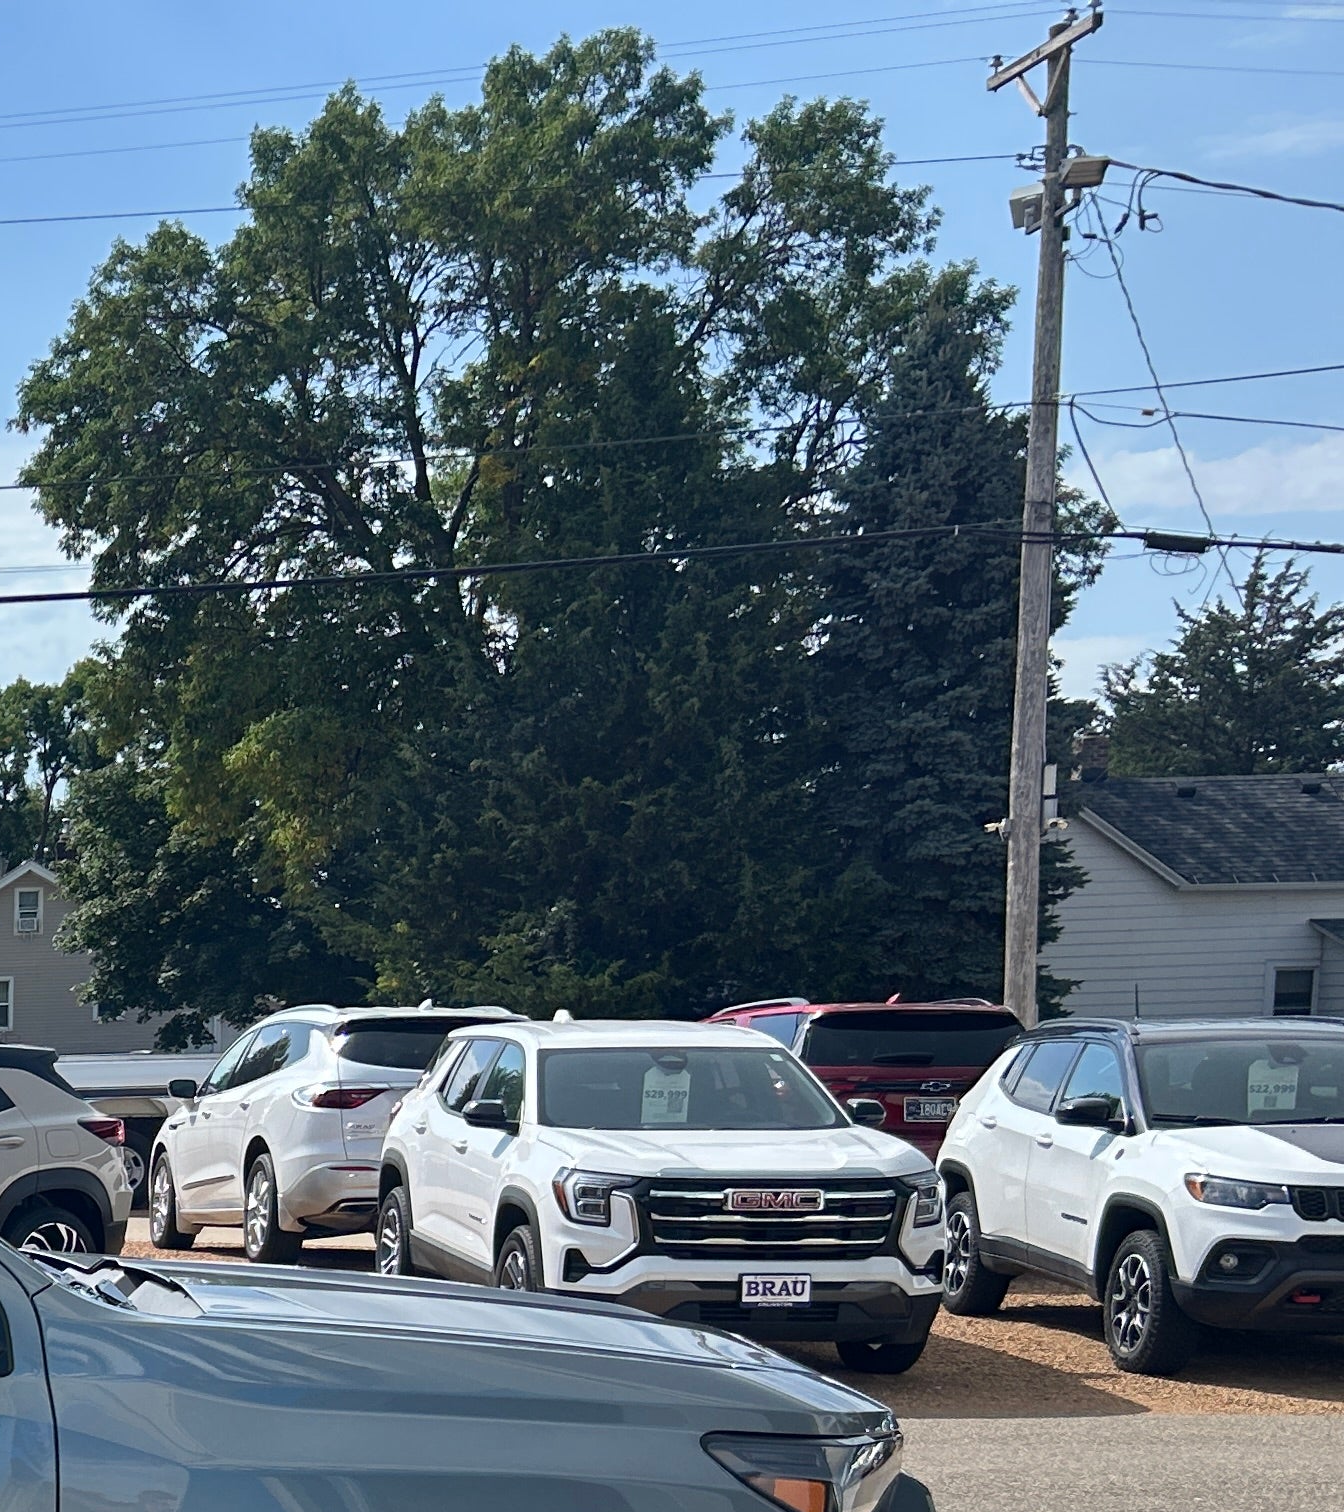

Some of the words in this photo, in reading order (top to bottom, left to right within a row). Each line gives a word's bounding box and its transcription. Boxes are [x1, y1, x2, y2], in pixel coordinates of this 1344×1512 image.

[644, 1089, 688, 1100] $29,999
[1249, 1084, 1296, 1094] $22,999
[733, 1192, 819, 1208] GMC
[745, 1281, 807, 1296] BRAU
